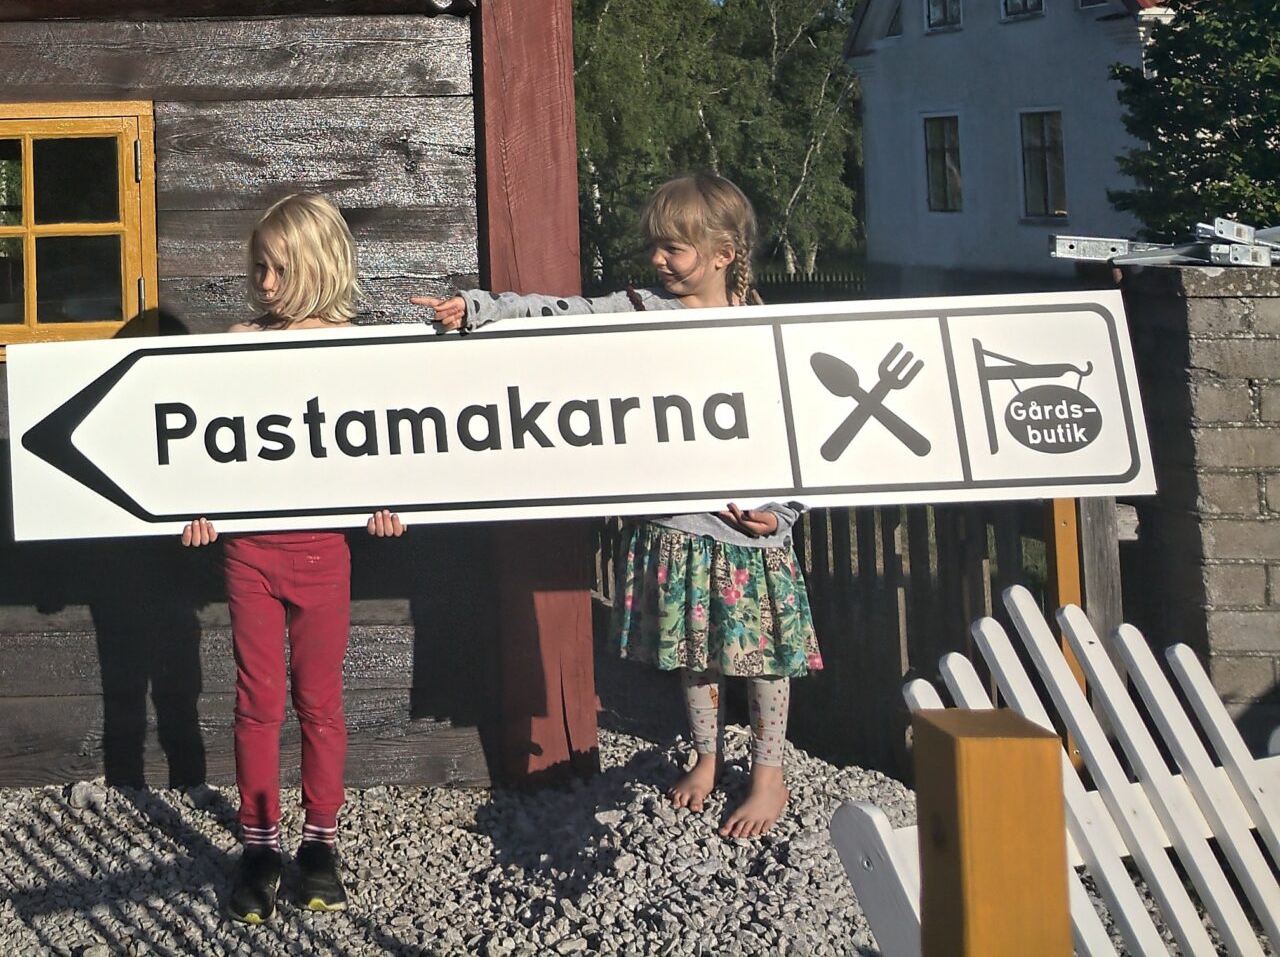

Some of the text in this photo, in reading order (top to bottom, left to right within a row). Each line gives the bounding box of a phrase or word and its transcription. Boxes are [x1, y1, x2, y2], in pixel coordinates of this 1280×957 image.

[1010, 399, 1097, 421] Gårds-
[154, 385, 750, 466] Pastamakarna
[1026, 423, 1088, 444] butik
